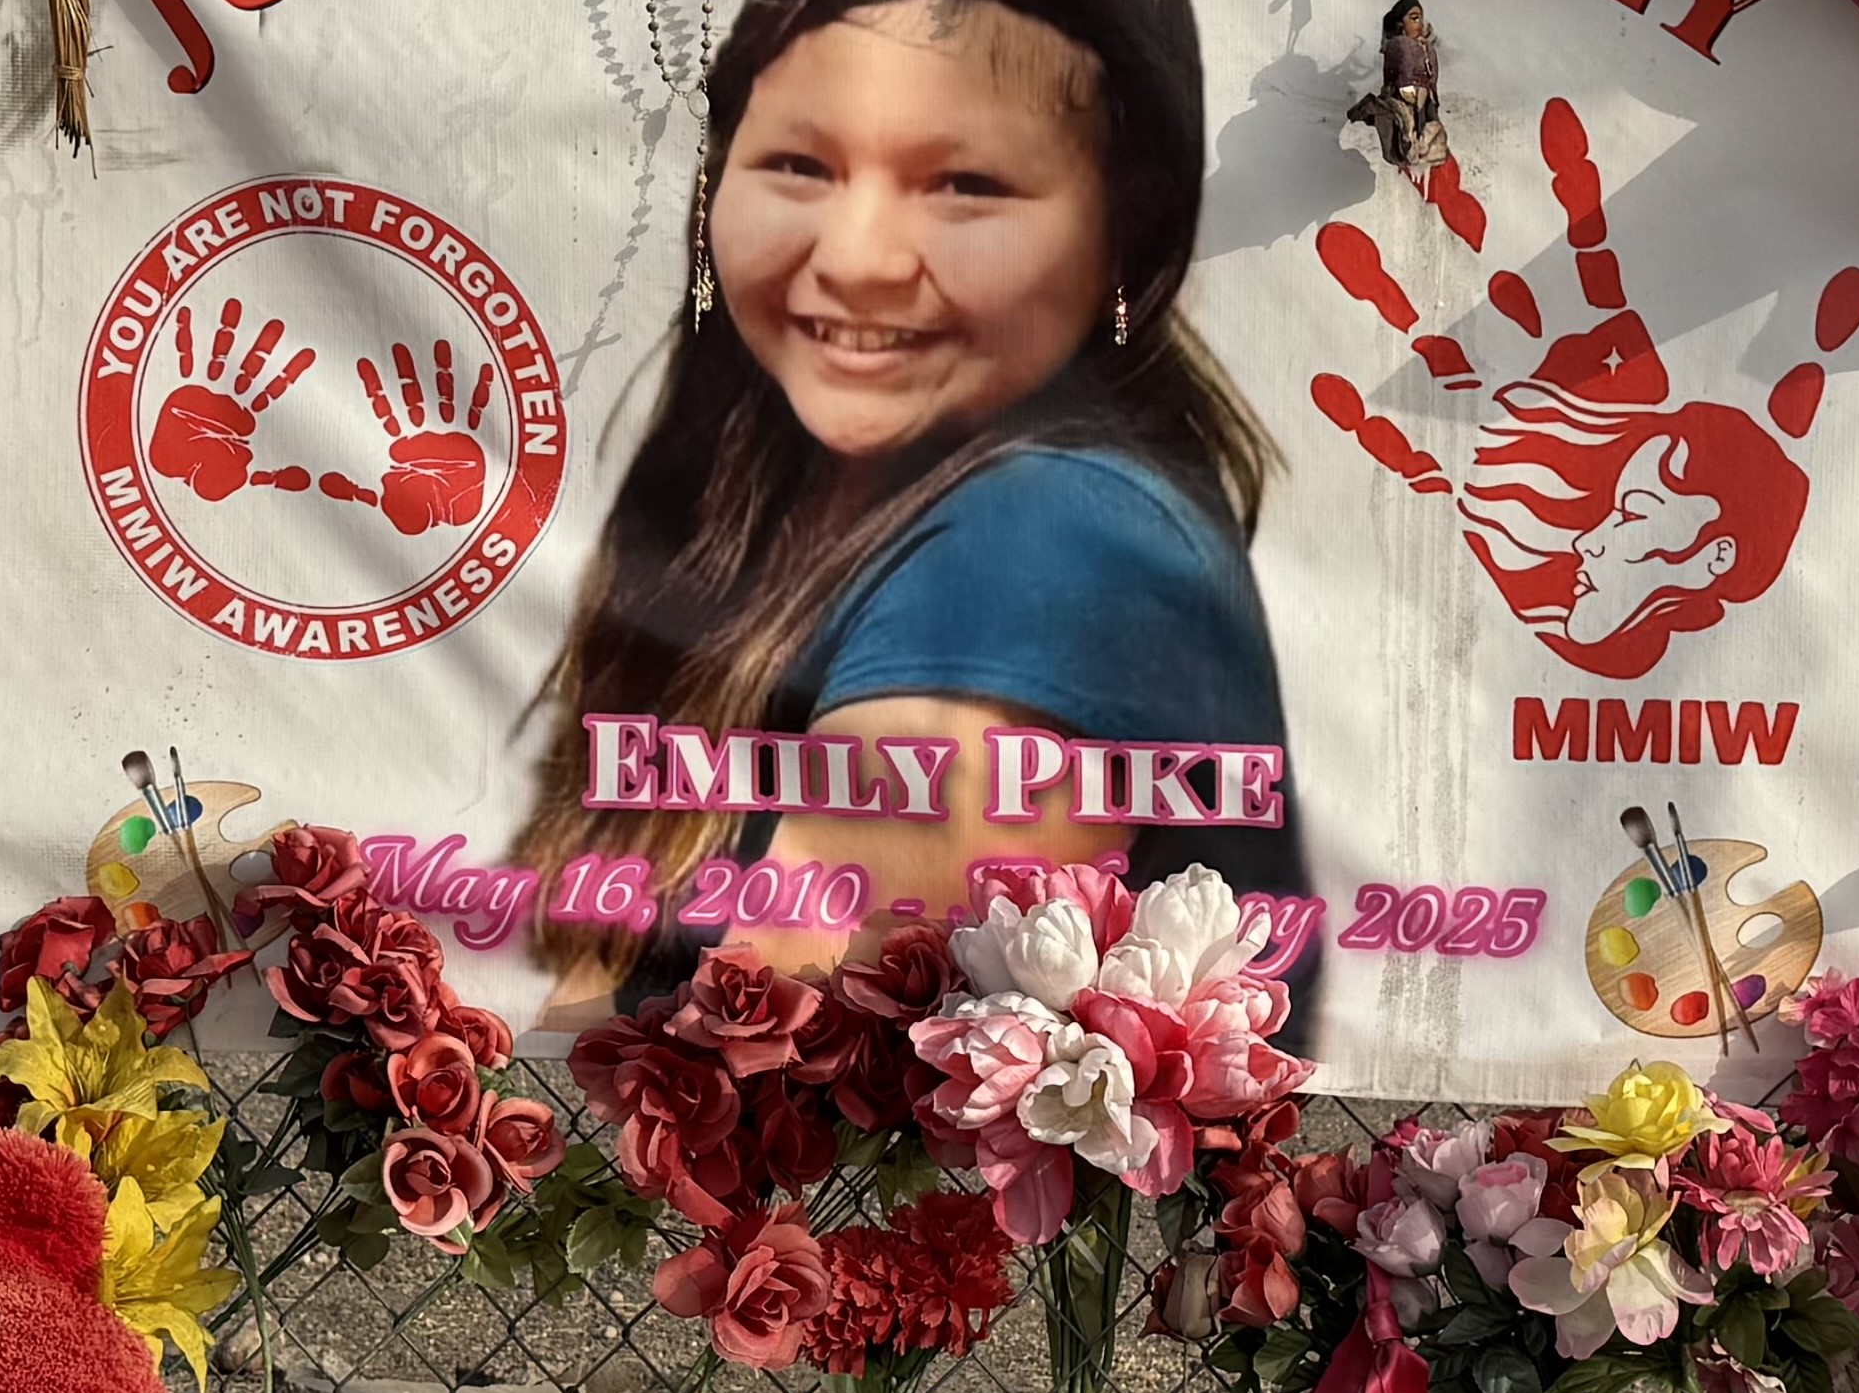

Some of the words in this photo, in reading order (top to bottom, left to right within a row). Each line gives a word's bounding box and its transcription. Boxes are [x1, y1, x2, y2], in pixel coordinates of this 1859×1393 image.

[97, 281, 164, 380] YOU
[160, 200, 251, 282] ARE
[258, 186, 355, 225] NOT
[370, 200, 559, 456] FORGOTTEN
[99, 464, 210, 603] MMIW
[212, 531, 518, 654] AWARENESS
[582, 713, 960, 822] EMILY
[983, 725, 1284, 829] PIKE
[1512, 696, 1800, 766] MMIW
[362, 833, 538, 952] May
[550, 853, 658, 931] 16,
[678, 857, 871, 931] 2010
[1338, 883, 1547, 959] 2025
